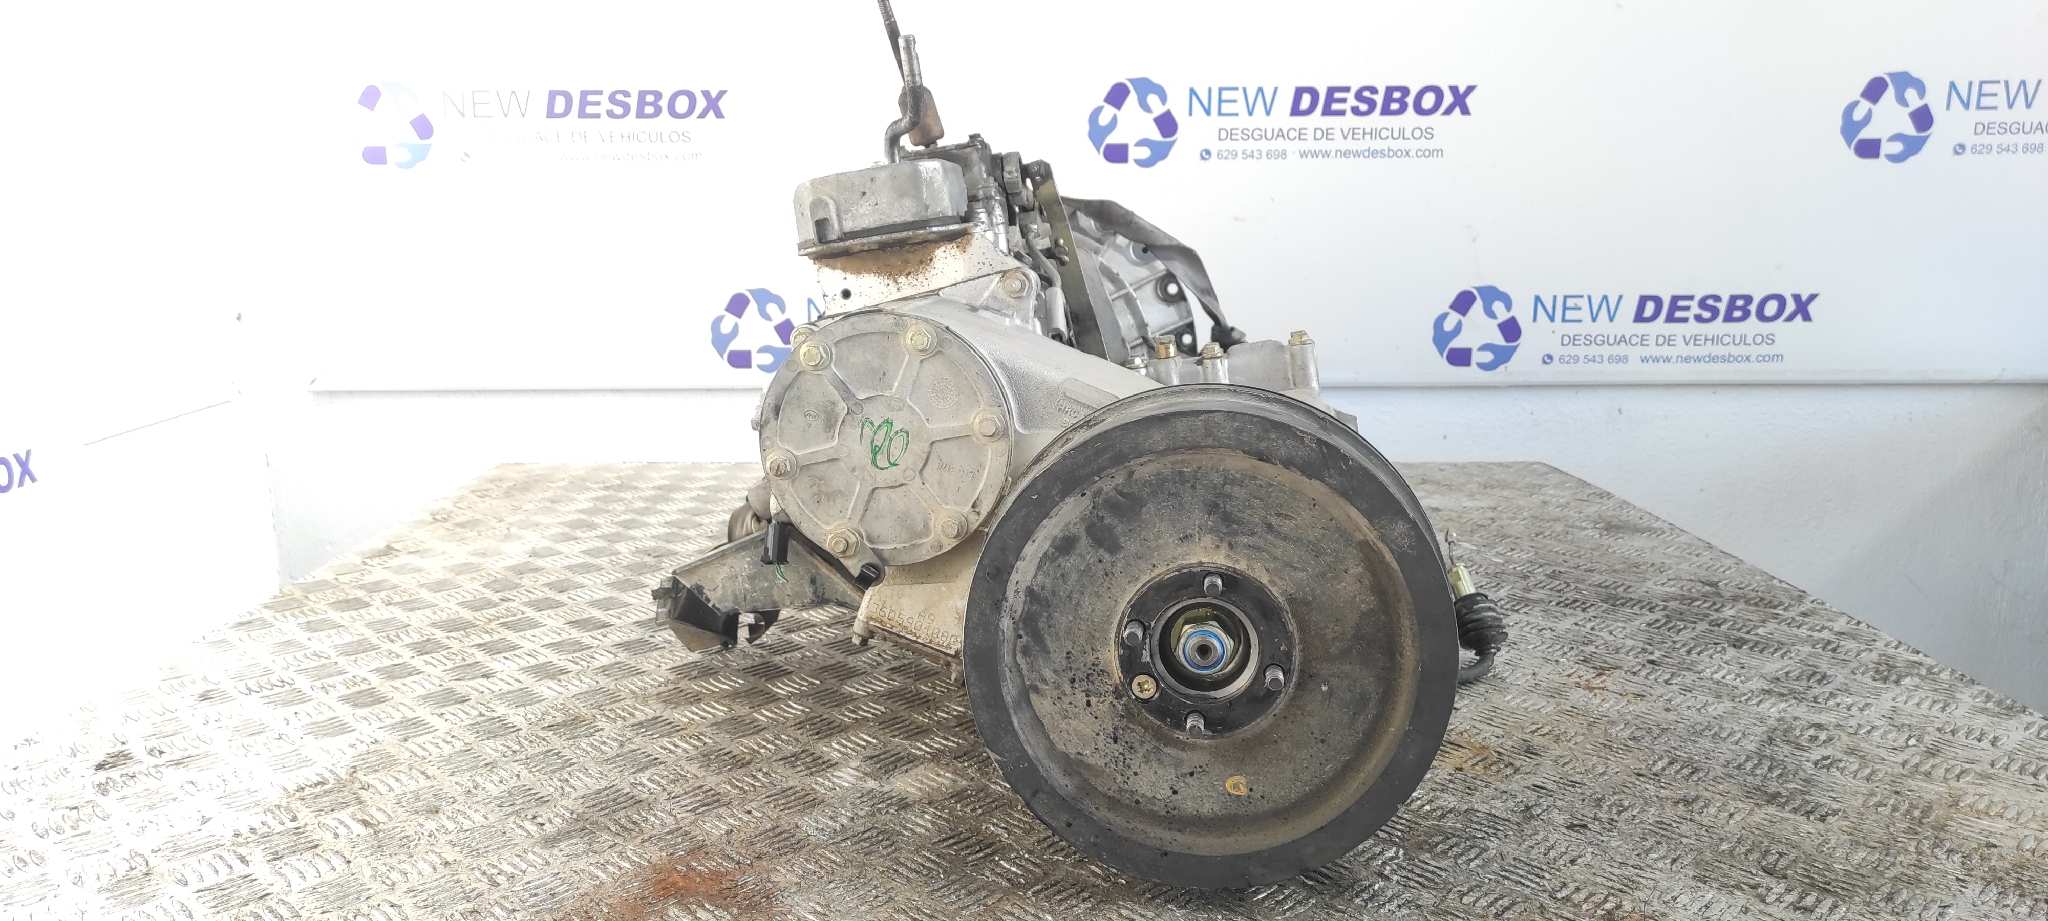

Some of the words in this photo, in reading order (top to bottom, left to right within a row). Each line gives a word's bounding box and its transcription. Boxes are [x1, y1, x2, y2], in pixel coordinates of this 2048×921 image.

[1187, 86, 1279, 118] NEW
[1289, 84, 1478, 117] DESBOX
[1945, 79, 2042, 112] NEW
[441, 90, 531, 119] NEW
[545, 89, 728, 120] DESBOX
[1217, 127, 1309, 142] DESGUACE
[1313, 127, 1336, 142] DE
[1340, 126, 1435, 141] VEHICULOS
[1974, 121, 2048, 136] DESGUA
[1217, 148, 1239, 160] 629
[1241, 148, 1263, 160] 543
[1266, 148, 1288, 160] 698
[1299, 146, 1444, 160] www.newdesbox.com
[1969, 143, 1993, 155] 629
[1996, 143, 2018, 154] 543
[2021, 142, 2044, 154] 698
[1532, 294, 1623, 324] NEW
[1632, 292, 1820, 324] DESBOX
[1560, 334, 1650, 347] DESGUACE
[1655, 334, 1677, 347] DE
[1682, 333, 1776, 346] VEHICULOS
[1558, 354, 1580, 365] 629
[1583, 354, 1605, 365] 543
[1607, 354, 1629, 365] 698
[1640, 352, 1784, 364] www.newdesbox.com
